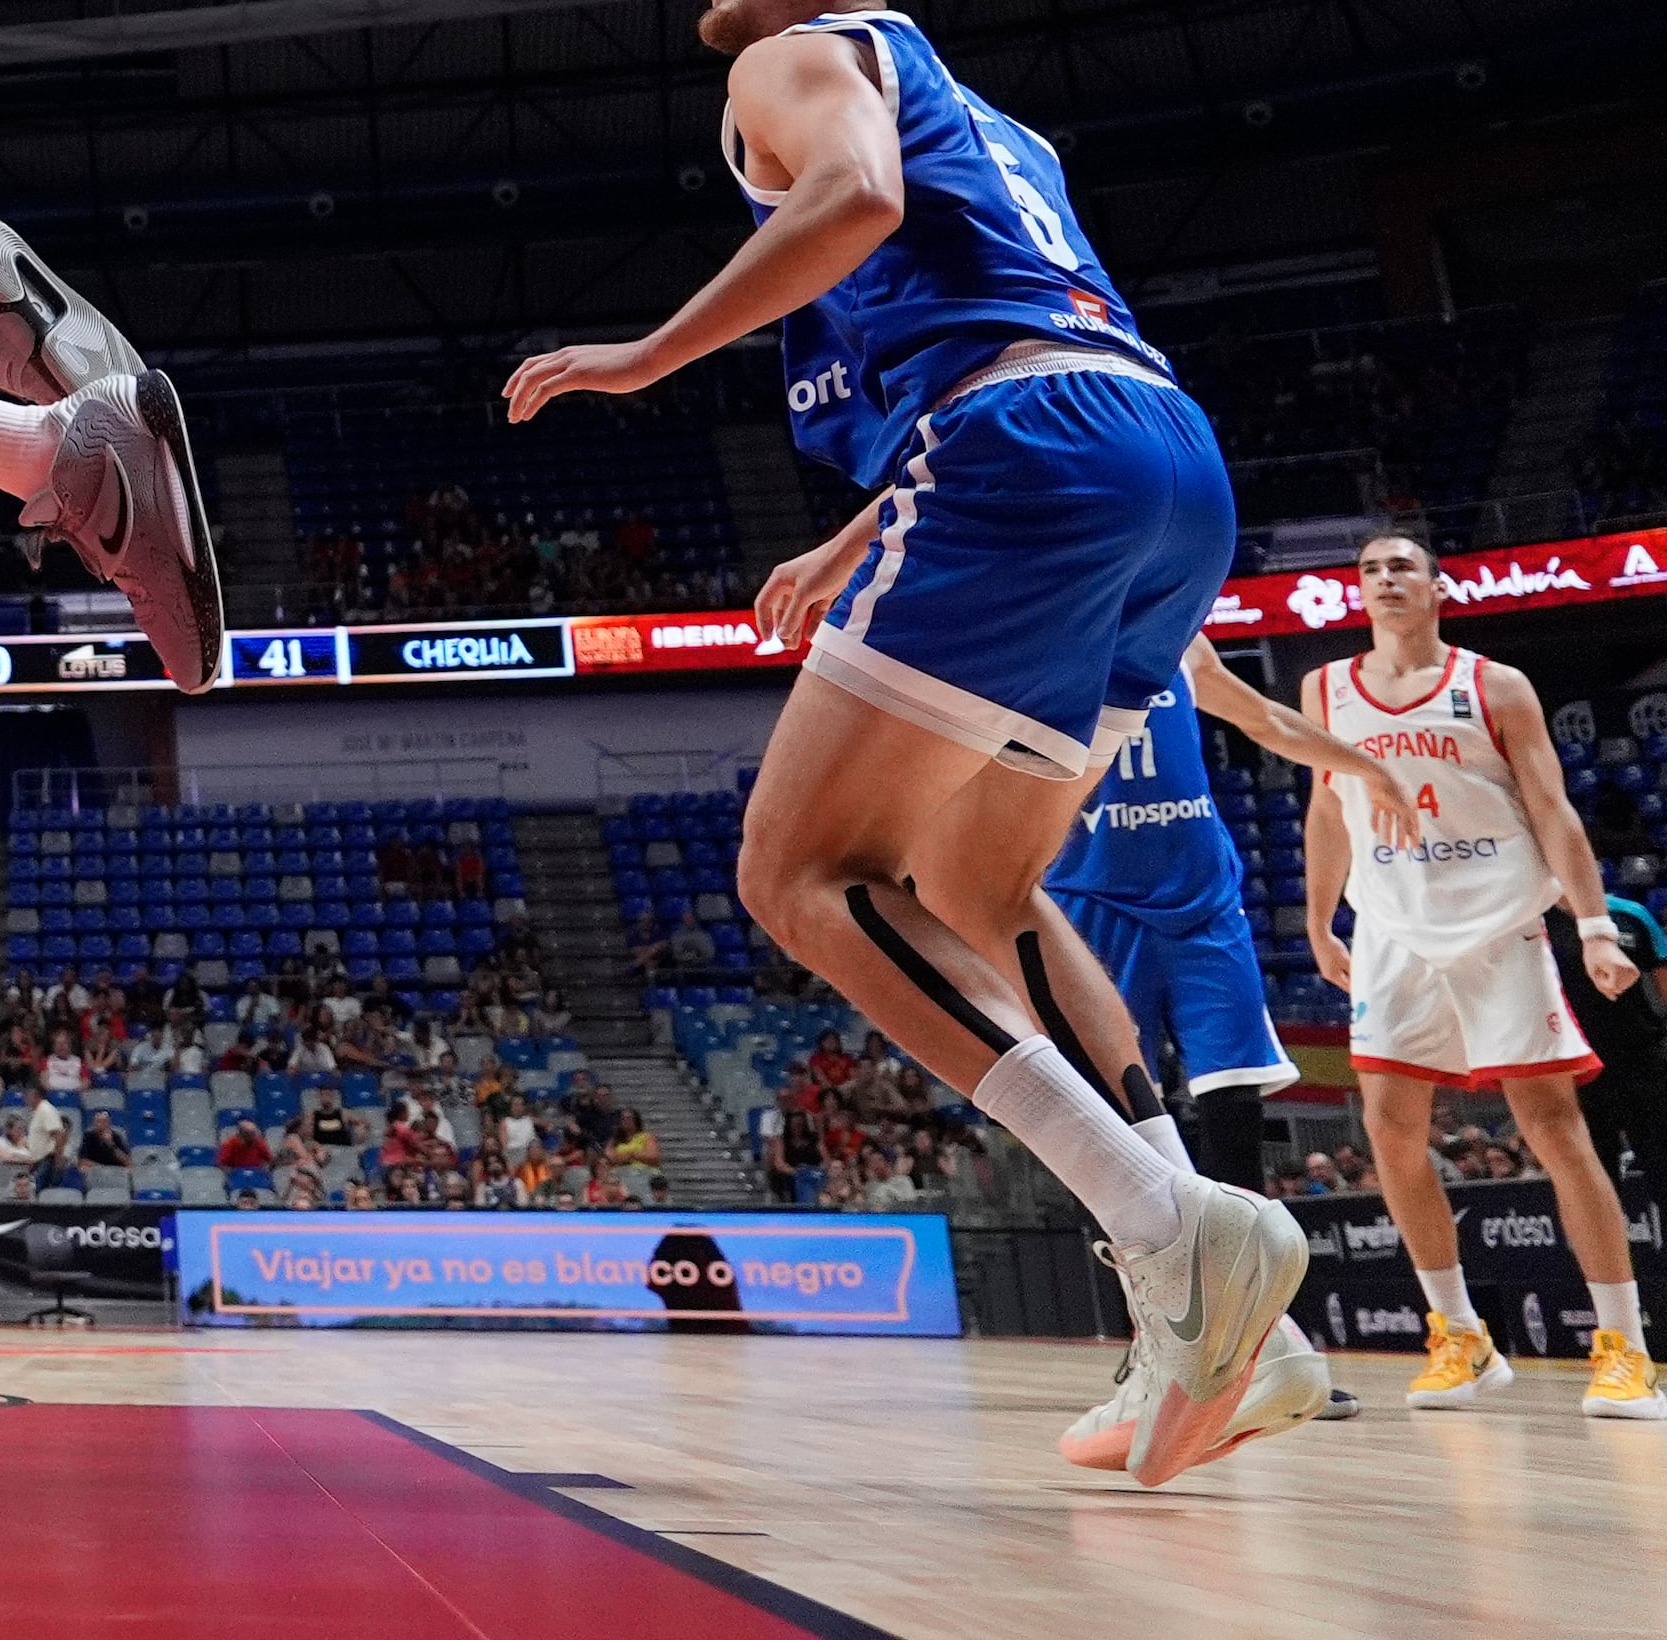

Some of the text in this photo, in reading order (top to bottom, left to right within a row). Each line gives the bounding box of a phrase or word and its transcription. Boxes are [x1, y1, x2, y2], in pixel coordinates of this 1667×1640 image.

[402, 634, 534, 669] CHEQUIA
[651, 622, 758, 650] IBERIA
[258, 637, 307, 678] 41
[1105, 794, 1213, 831] Tipsport
[1418, 782, 1440, 818] 4
[252, 1249, 864, 1295] Viajar ya no es blanco o negro
